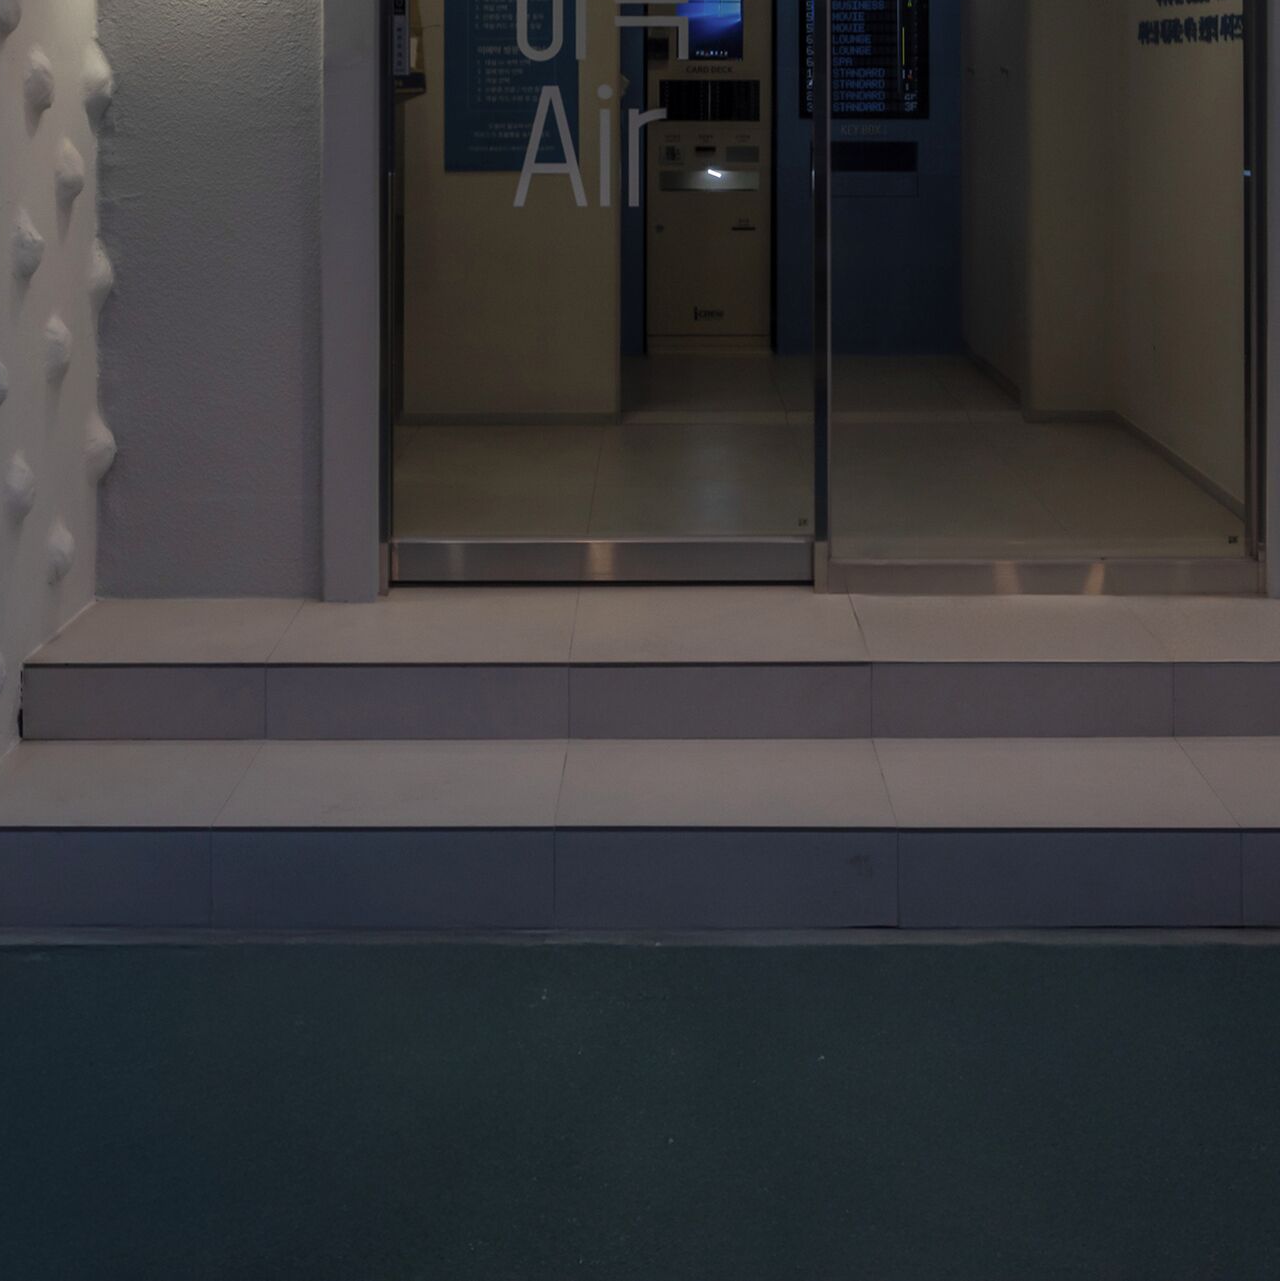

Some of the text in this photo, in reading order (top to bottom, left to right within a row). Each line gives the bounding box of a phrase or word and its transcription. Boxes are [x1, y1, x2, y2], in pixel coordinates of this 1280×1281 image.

[686, 65, 733, 74] CARD DECK
[831, 68, 885, 78] STANDARD
[831, 80, 885, 89] STANDARD
[831, 102, 885, 112] STANDARD
[513, 84, 667, 207] Air
